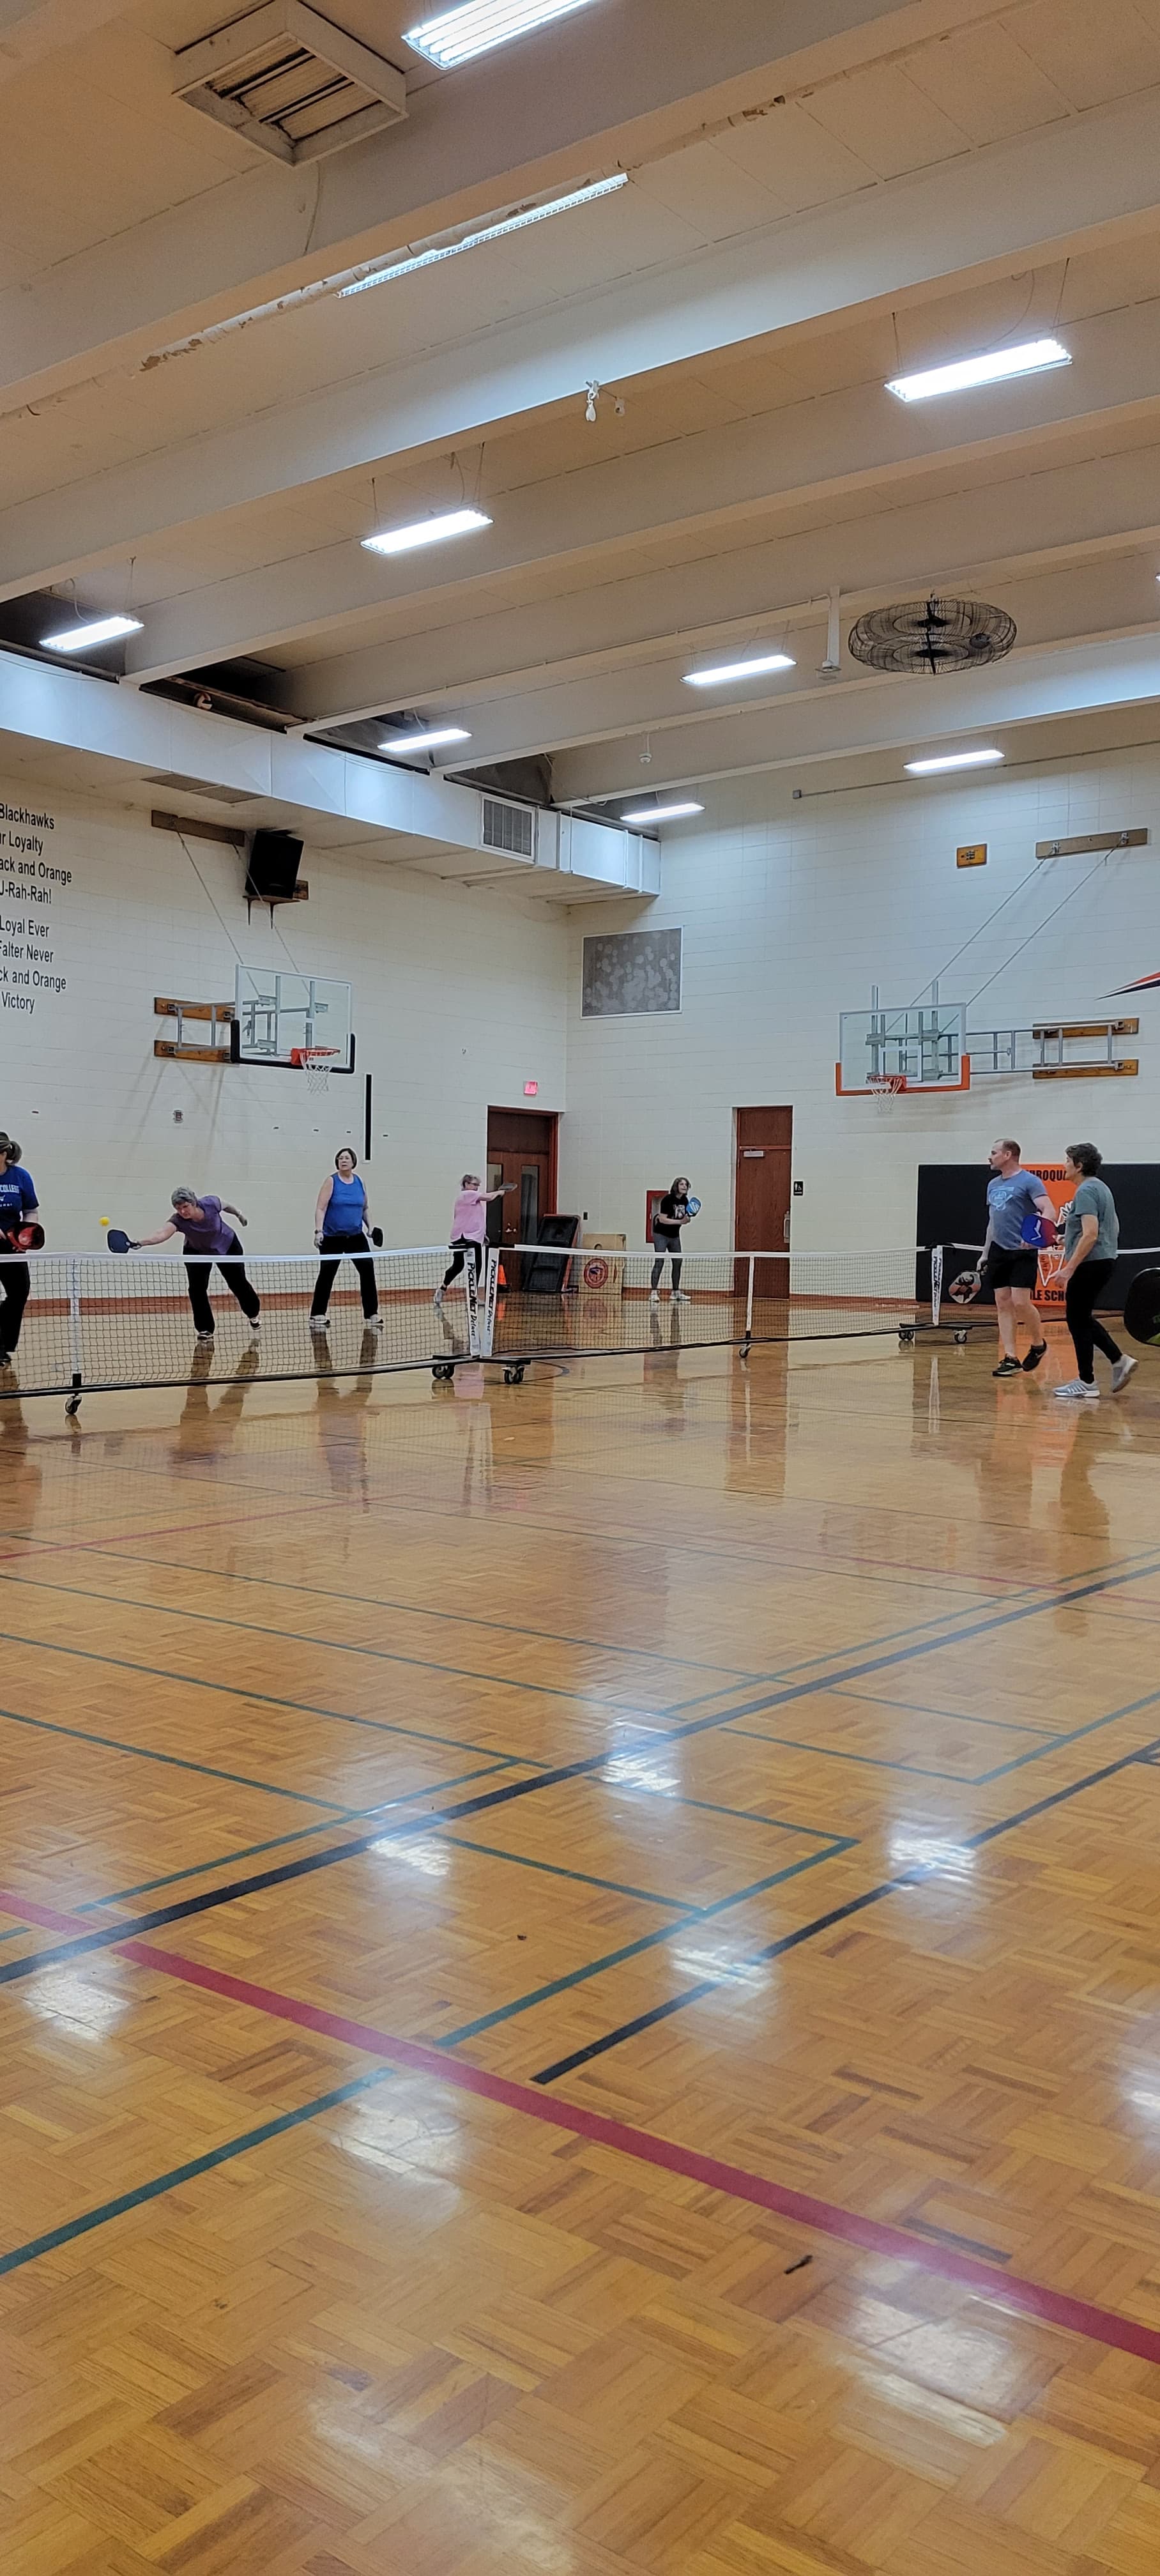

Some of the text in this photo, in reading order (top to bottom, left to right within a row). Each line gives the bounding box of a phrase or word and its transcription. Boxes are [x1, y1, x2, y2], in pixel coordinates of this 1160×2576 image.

[0, 803, 54, 829] Blackhawks
[9, 831, 43, 856] Loyalty
[18, 861, 35, 876] and
[38, 862, 72, 885] Orange
[0, 914, 49, 937] Loyal Ever
[27, 944, 54, 963] Never
[12, 969, 29, 985] and
[33, 970, 66, 993] Orange
[1, 992, 34, 1014] Victory
